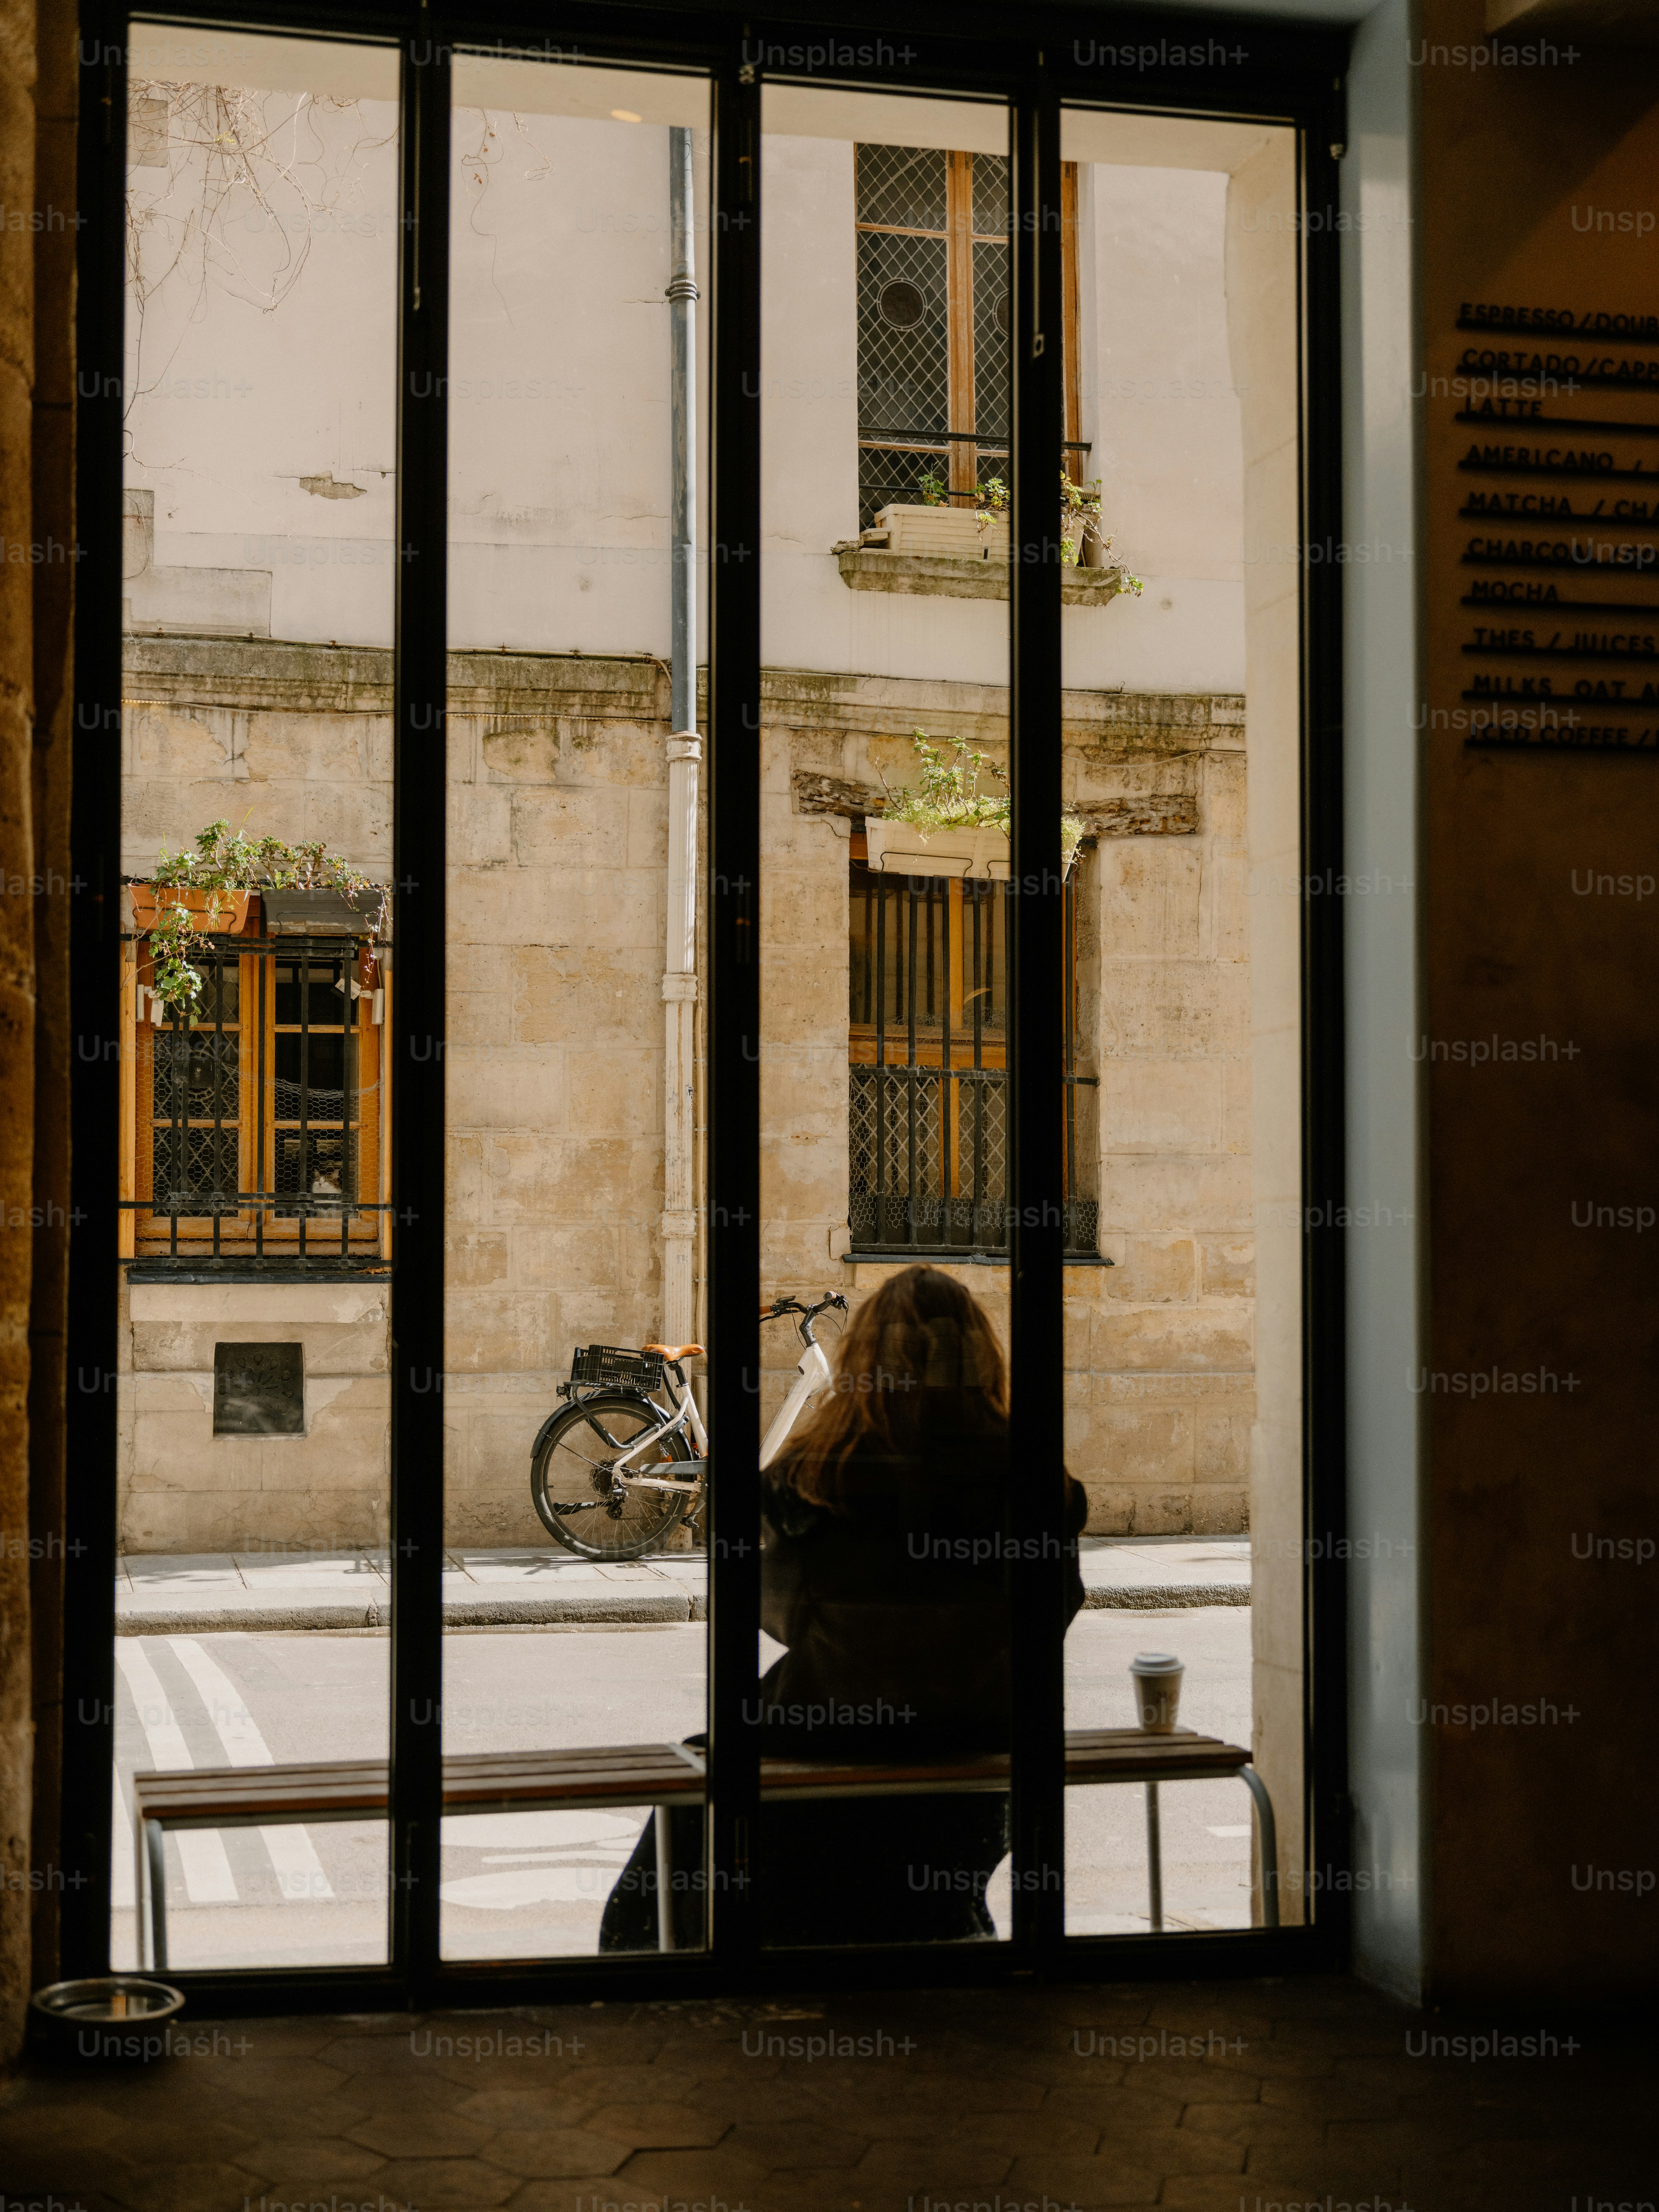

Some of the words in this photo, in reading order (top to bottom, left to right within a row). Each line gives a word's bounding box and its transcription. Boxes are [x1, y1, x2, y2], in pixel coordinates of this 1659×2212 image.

[1465, 395, 1542, 417] LATTE
[1467, 444, 1613, 470] AMERICANO
[1468, 491, 1572, 515] MATCHA
[1472, 580, 1558, 602] MOCHA
[1473, 627, 1534, 648] THES
[1568, 633, 1656, 653] JUICES
[1473, 674, 1551, 696] MILKS
[1575, 679, 1627, 698] OAT
[1641, 682, 1659, 700] A
[1539, 725, 1628, 745] COFFEE
